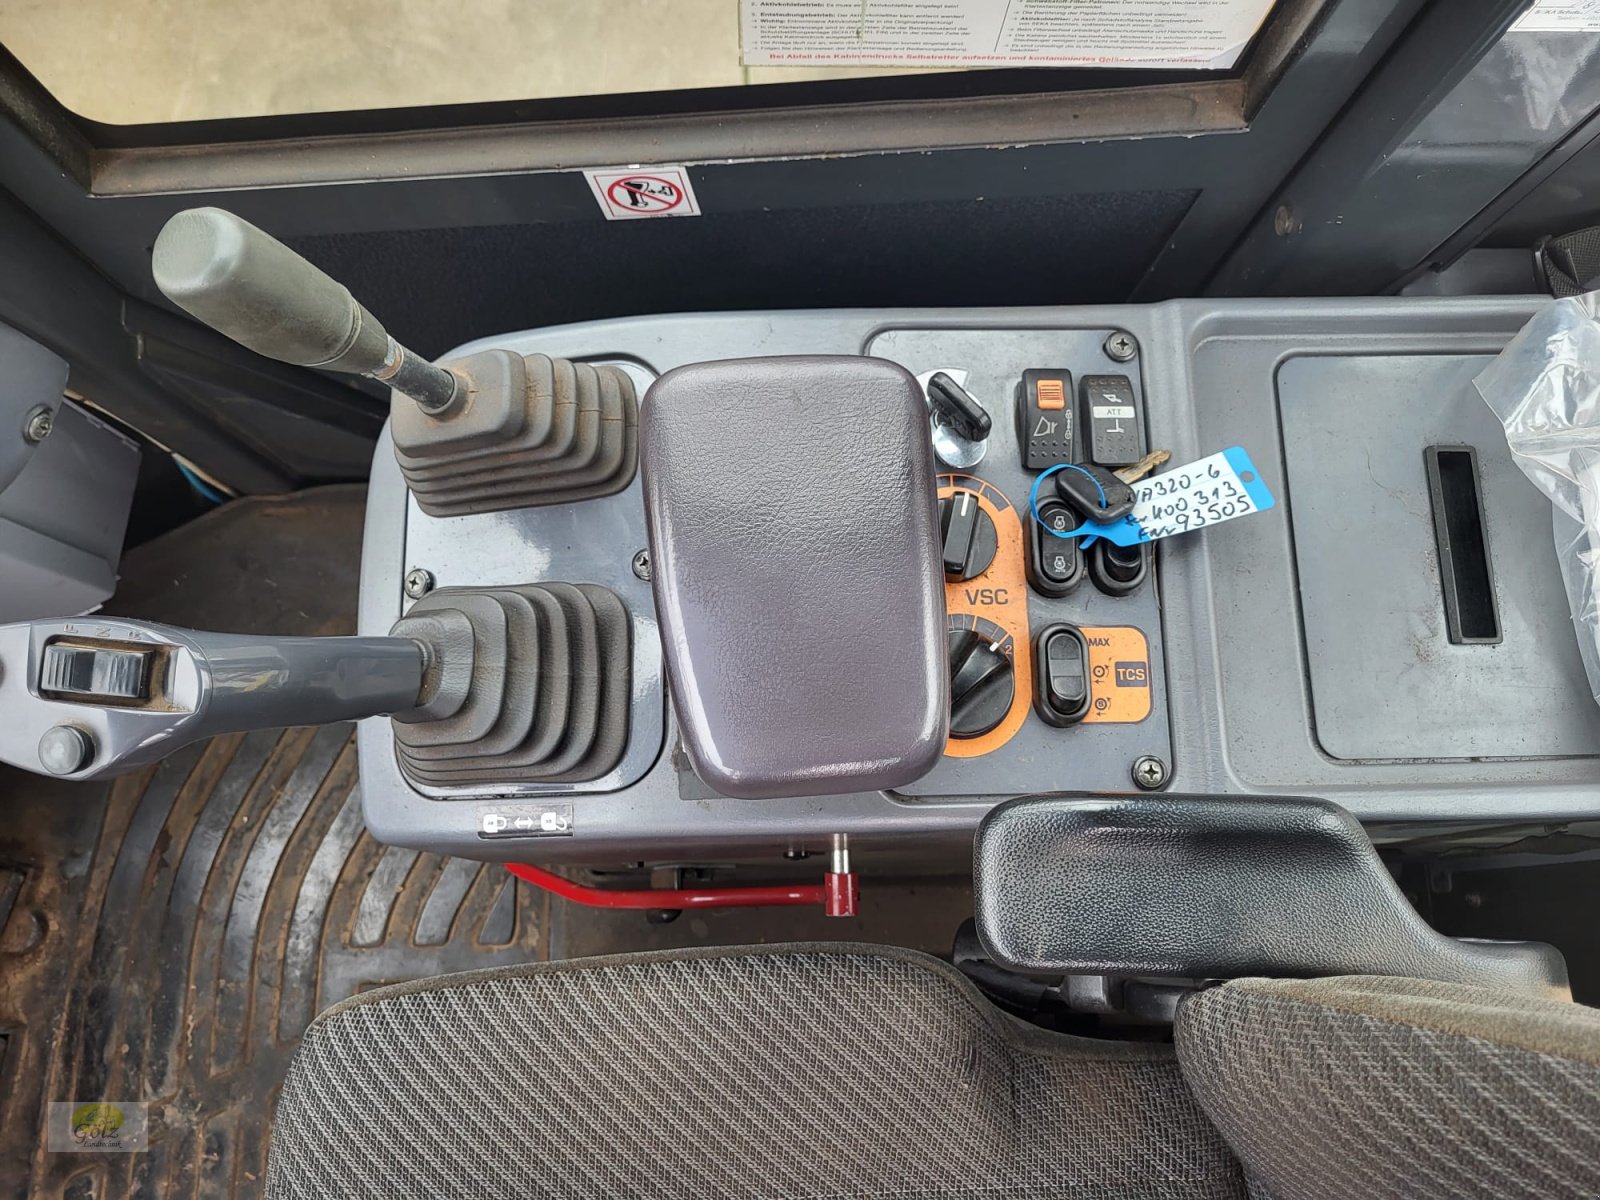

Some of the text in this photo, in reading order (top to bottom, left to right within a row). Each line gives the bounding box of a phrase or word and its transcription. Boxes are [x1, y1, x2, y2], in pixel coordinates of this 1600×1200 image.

[1194, 481, 1237, 505] 313
[1176, 494, 1250, 531] 93505
[965, 589, 1008, 606] VSC
[1088, 638, 1110, 646] MAX
[1117, 668, 1145, 680] TCS
